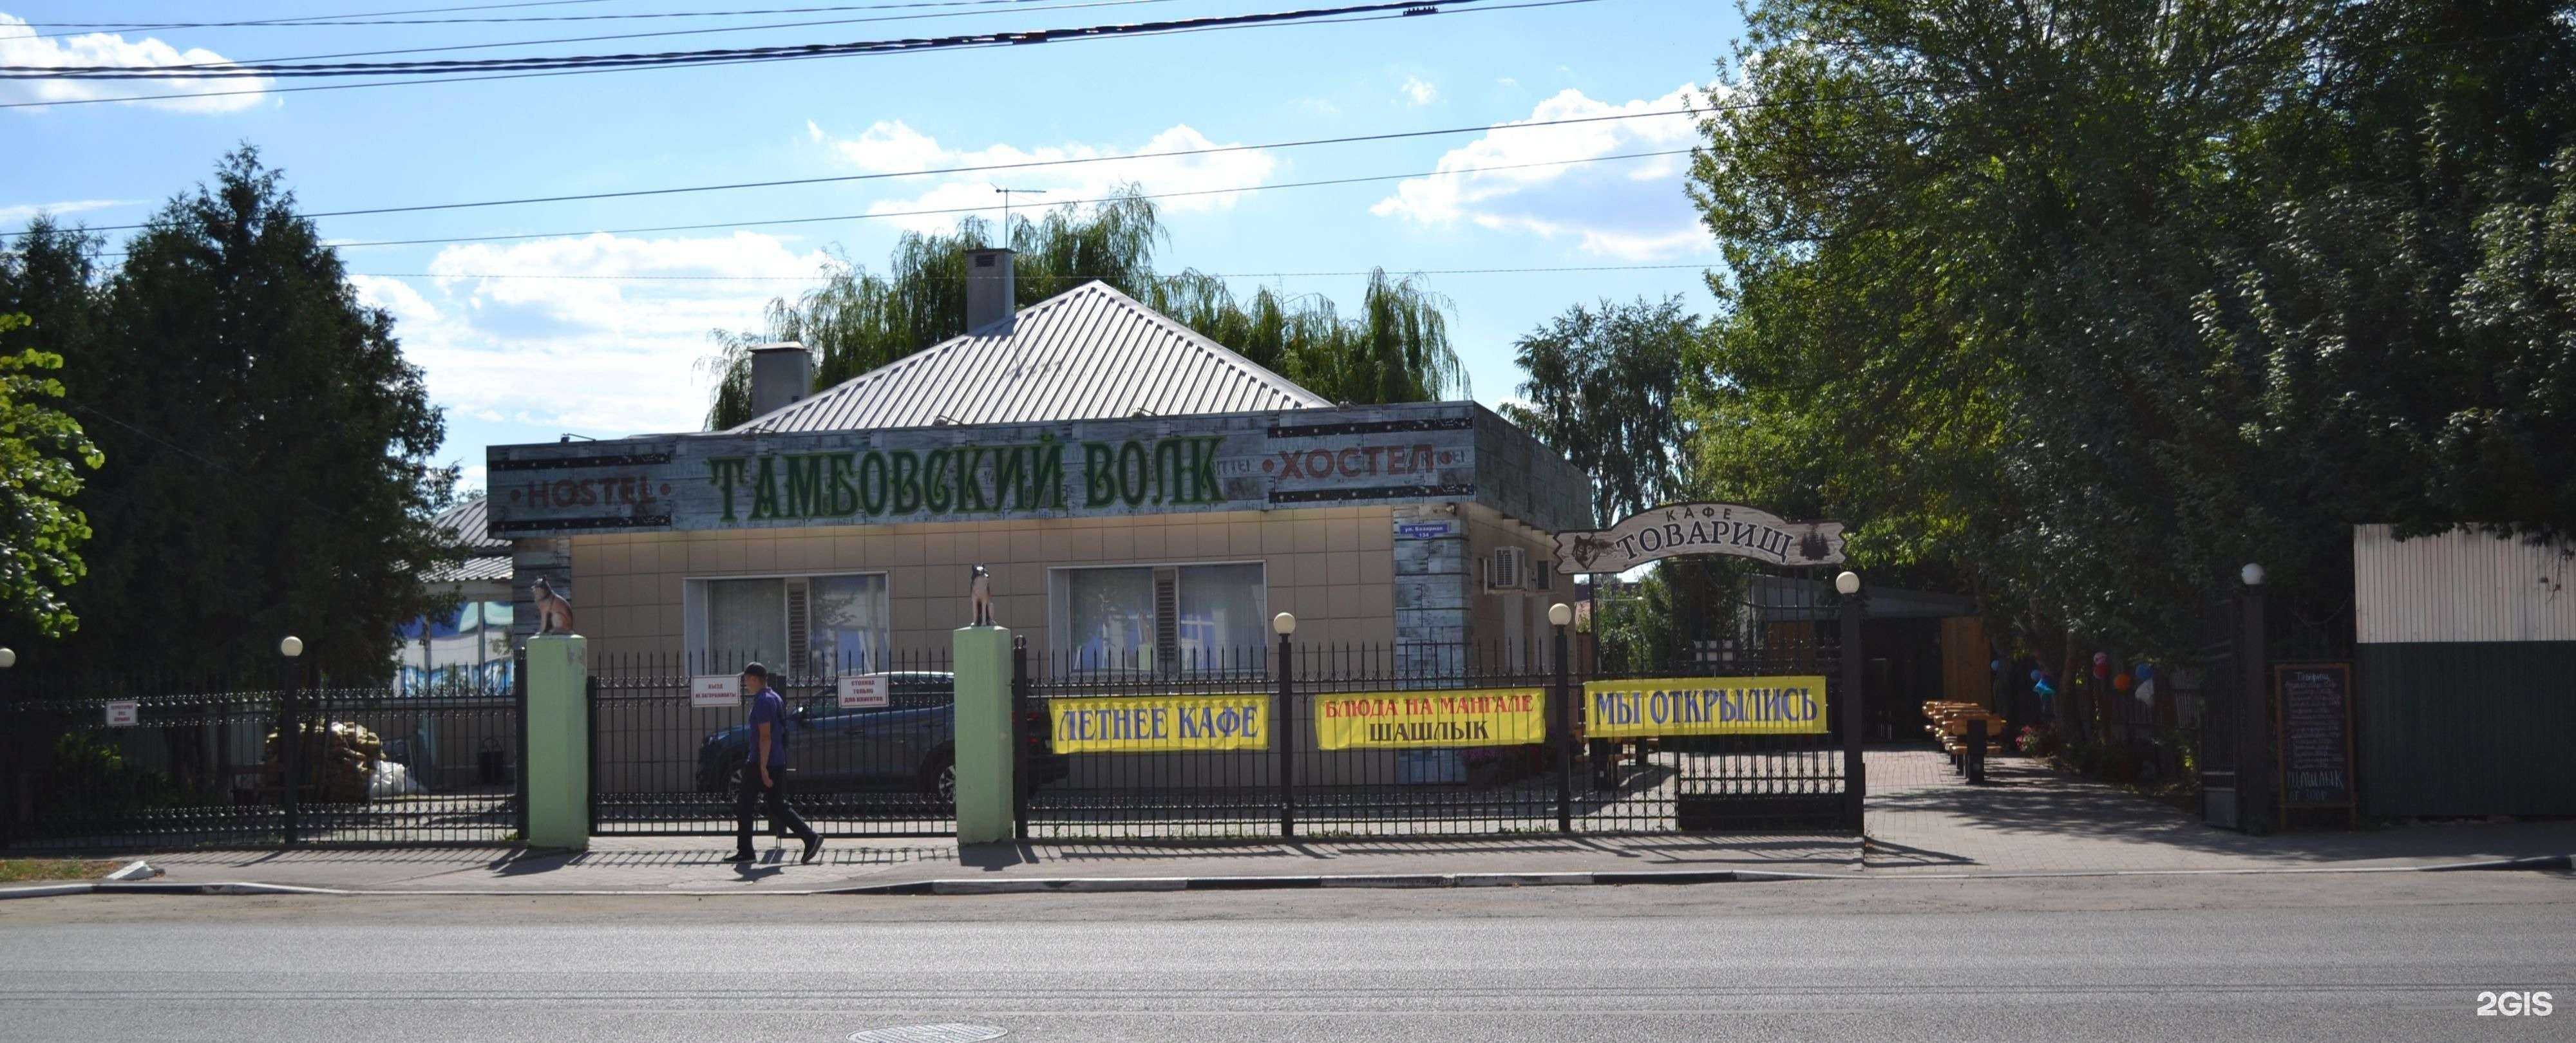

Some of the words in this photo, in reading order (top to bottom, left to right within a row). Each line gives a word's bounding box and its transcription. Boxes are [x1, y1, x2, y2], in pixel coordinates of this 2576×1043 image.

[706, 432, 1065, 522] ТАМБОВСКИЙ
[1081, 435, 1227, 509] ВОЛК
[1278, 444, 1434, 480] ХОСТЕЛ
[527, 475, 657, 508] HOSTEL
[1666, 506, 1732, 522] КАФЕ
[1616, 520, 1795, 565] ТОВАРИЩ
[1058, 709, 1168, 741] ЛЕТНЕЕ
[1179, 706, 1260, 738] КАФЕ
[1325, 699, 1399, 719] БЛЮДА
[1406, 698, 1434, 715] НА
[1441, 695, 1535, 714] МАНГАЛЕ
[1595, 691, 1642, 725] МЫ
[1650, 688, 1817, 724] ОТКРЫЛИСЬ
[1370, 720, 1489, 742] ШАШЛЫК
